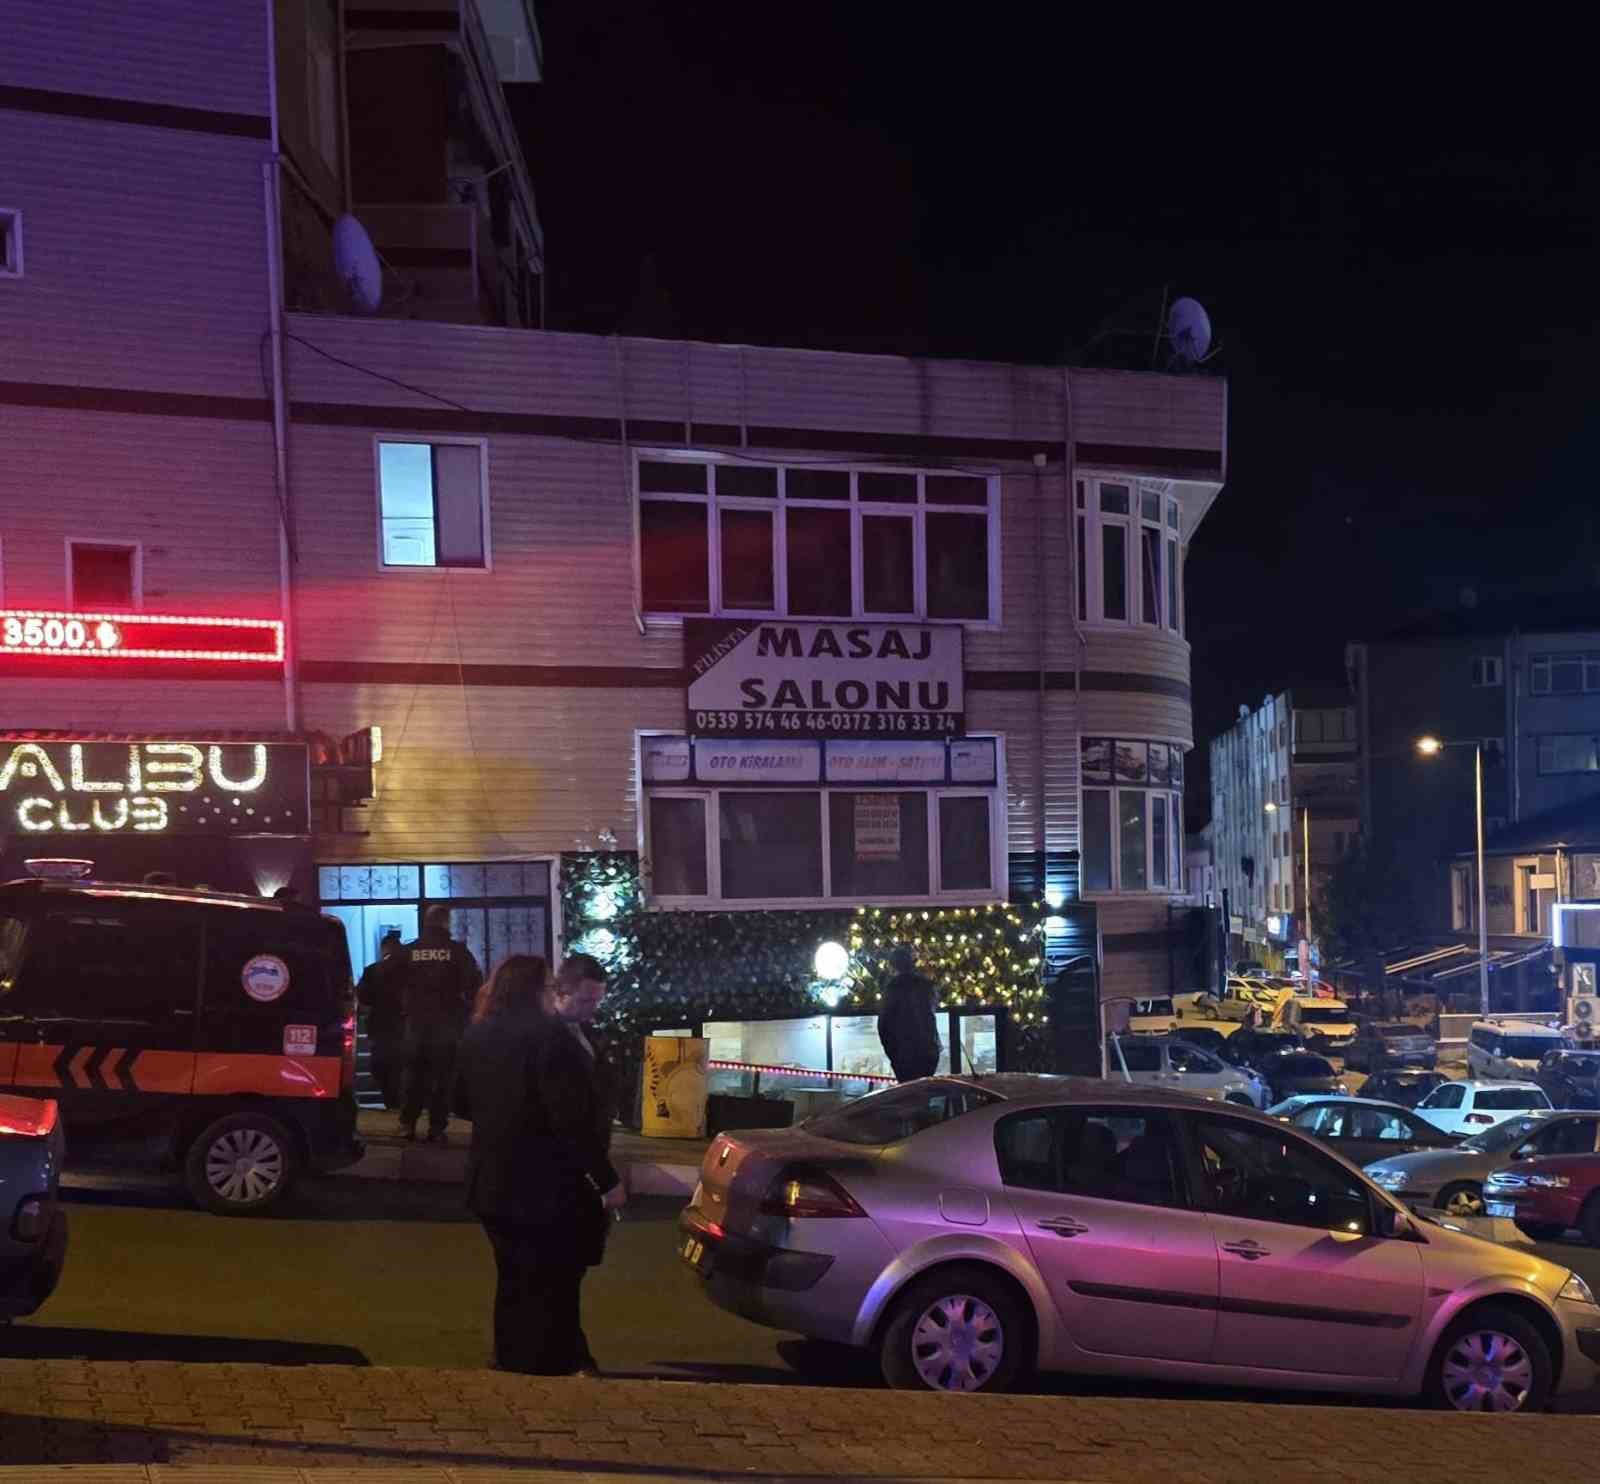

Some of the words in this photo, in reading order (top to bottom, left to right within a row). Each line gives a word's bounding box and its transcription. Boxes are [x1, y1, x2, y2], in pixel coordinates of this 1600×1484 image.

[756, 627, 932, 660] MASAJ
[739, 677, 949, 710] SALONU
[696, 711, 738, 729] 0539
[744, 711, 775, 730] 574
[780, 713, 801, 730] 46
[877, 714, 906, 731] 316
[911, 714, 931, 731] 33
[936, 714, 956, 731] 24
[710, 755, 737, 769] OTO
[18, 796, 169, 831] CLUB
[290, 1029, 313, 1043] 112
